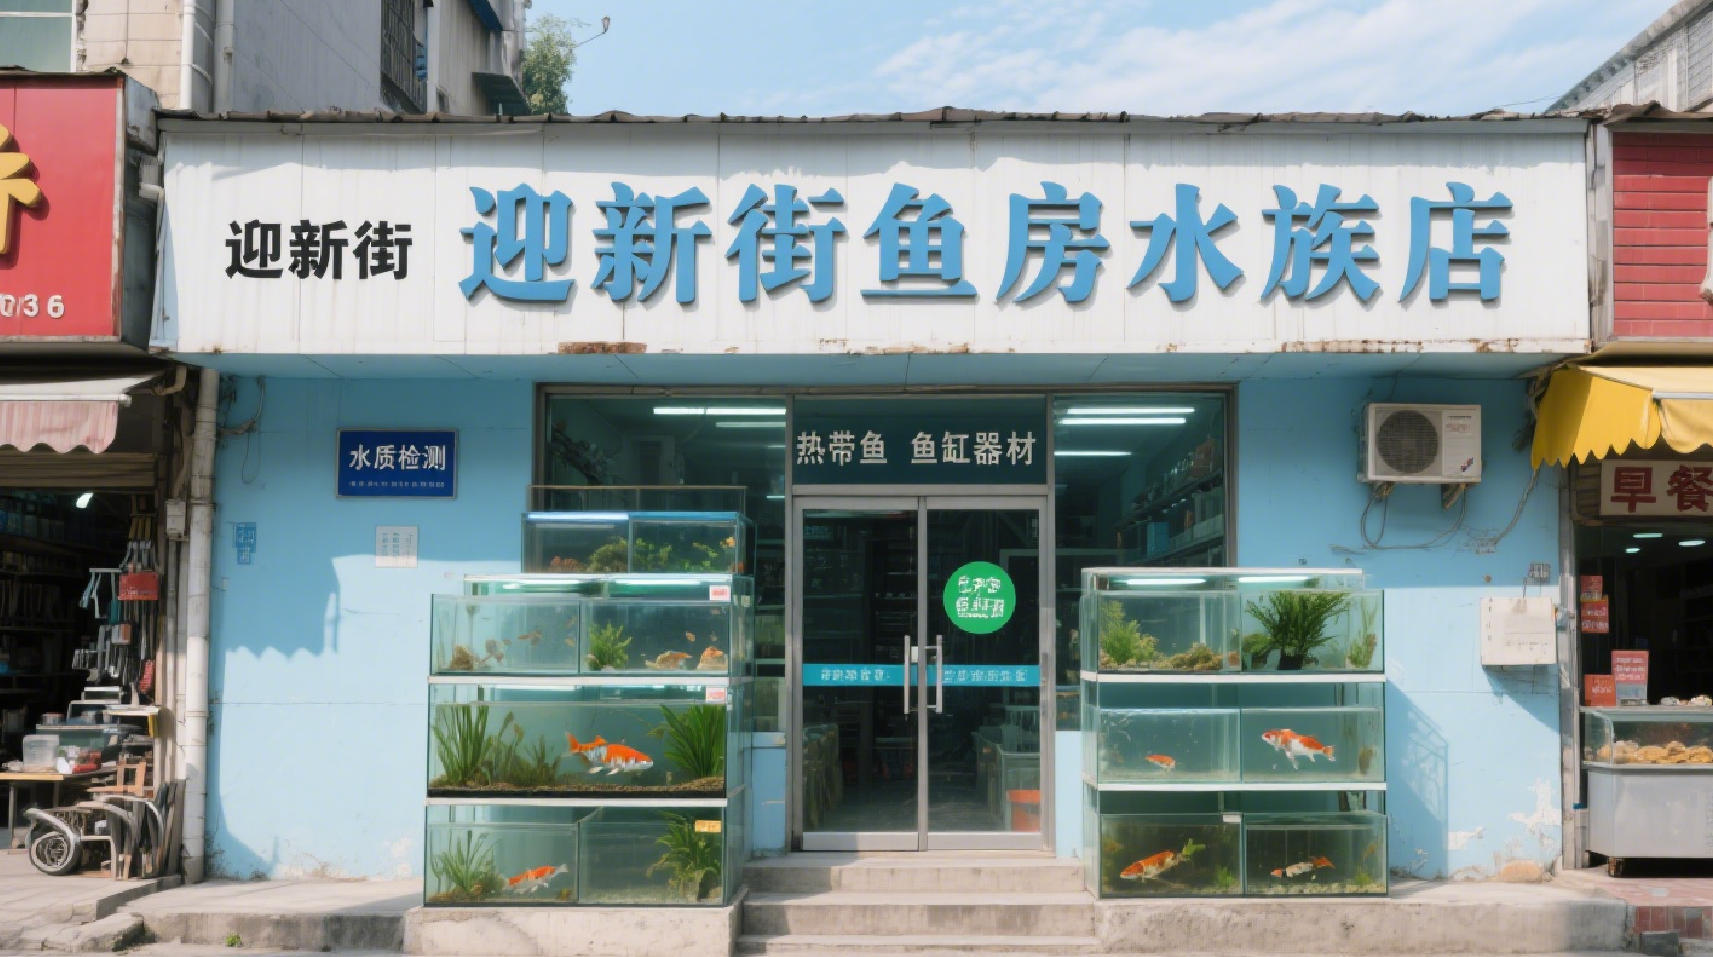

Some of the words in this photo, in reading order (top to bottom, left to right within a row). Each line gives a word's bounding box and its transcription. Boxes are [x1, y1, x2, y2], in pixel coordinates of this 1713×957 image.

[225, 219, 413, 280] 迎新街
[460, 181, 1511, 304] 迎新街鱼房水族店
[348, 443, 446, 471] 水质检测
[796, 430, 888, 466] 热带鱼
[911, 431, 1036, 465] 鱼缸器材
[1610, 464, 1713, 513] 早餐
